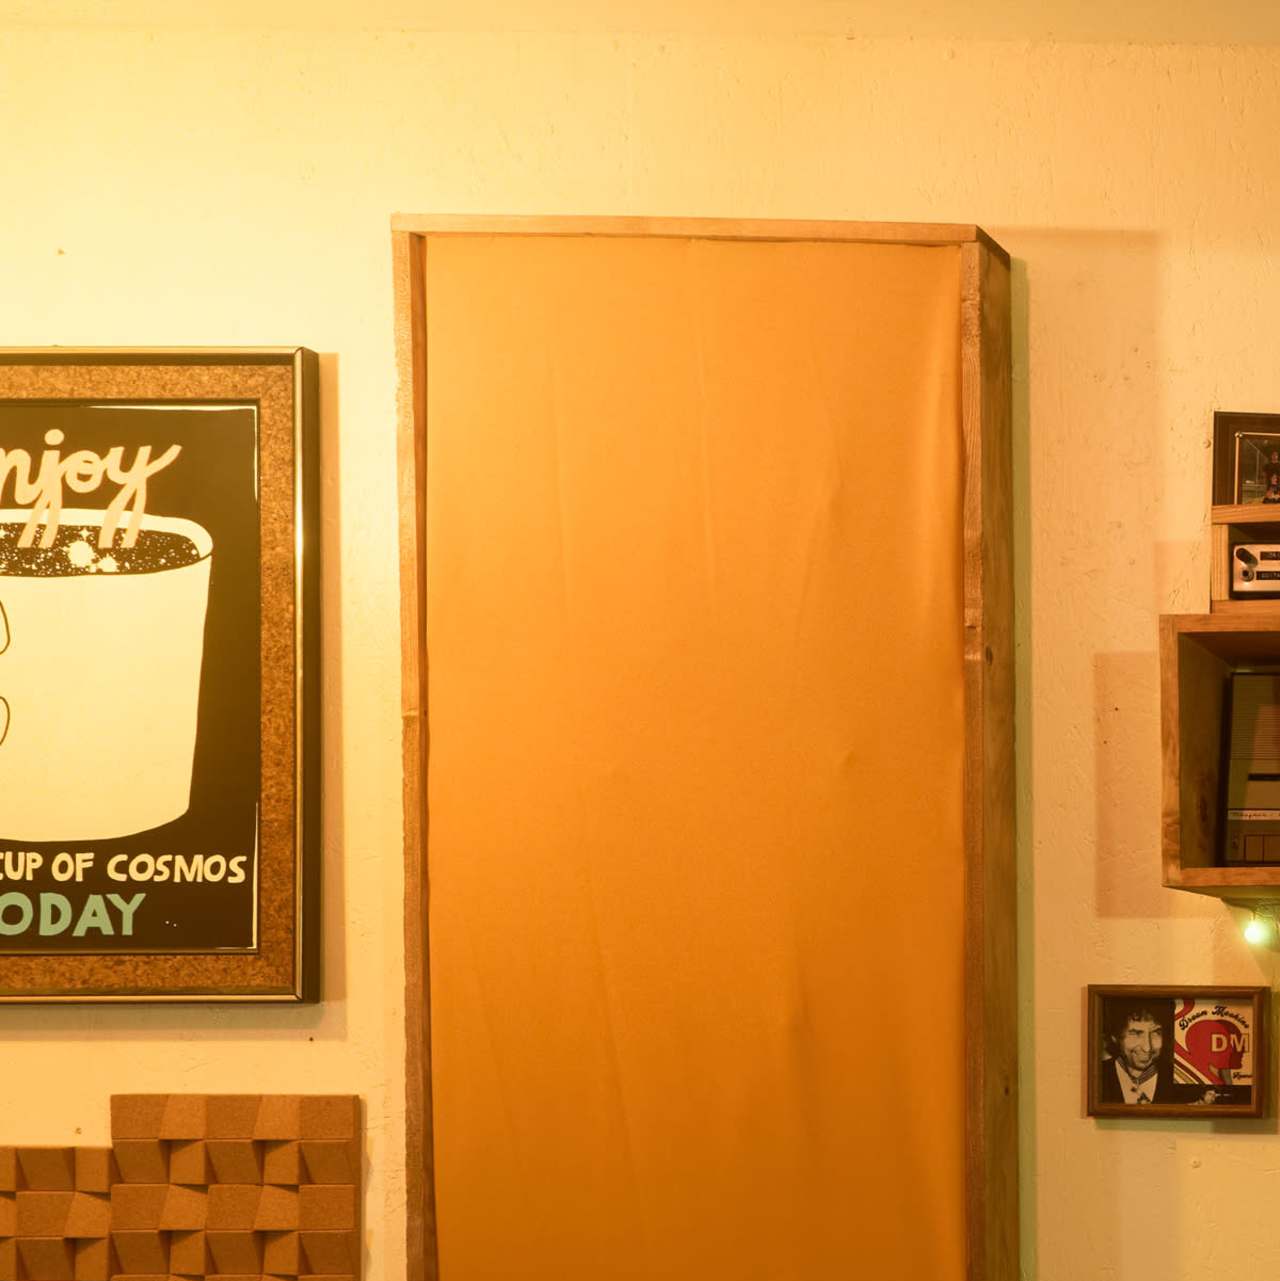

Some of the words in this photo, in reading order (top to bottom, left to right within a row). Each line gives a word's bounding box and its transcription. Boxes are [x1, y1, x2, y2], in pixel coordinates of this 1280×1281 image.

[0, 428, 182, 548] njoy
[0, 851, 43, 881] UP
[51, 852, 94, 882] OF
[106, 853, 247, 883] COSMOS
[0, 892, 146, 937] ODAY
[1179, 1010, 1207, 1030] Dream
[1211, 1033, 1249, 1052] DM
